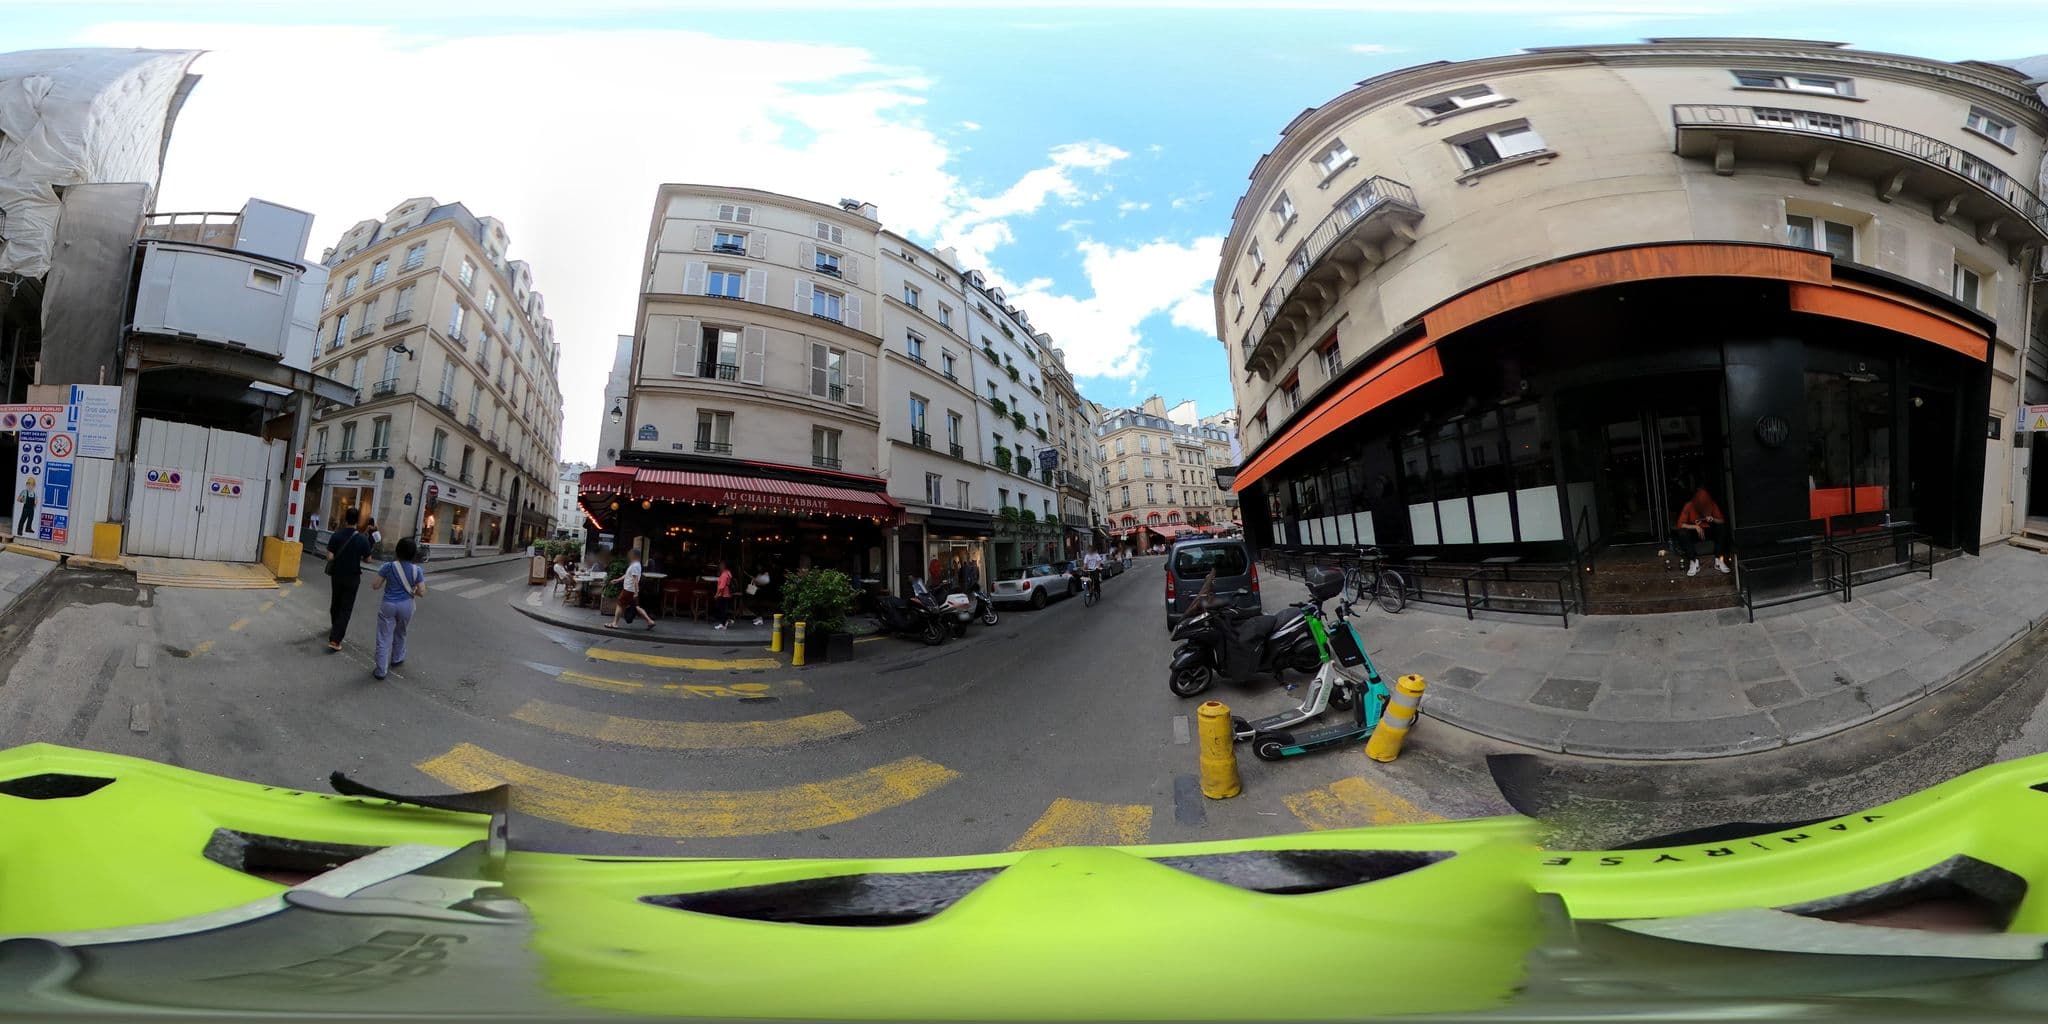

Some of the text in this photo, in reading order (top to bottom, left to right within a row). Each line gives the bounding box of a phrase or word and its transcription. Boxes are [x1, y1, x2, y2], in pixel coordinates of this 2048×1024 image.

[723, 491, 829, 508] AU CHAI DE L'ABBAYE
